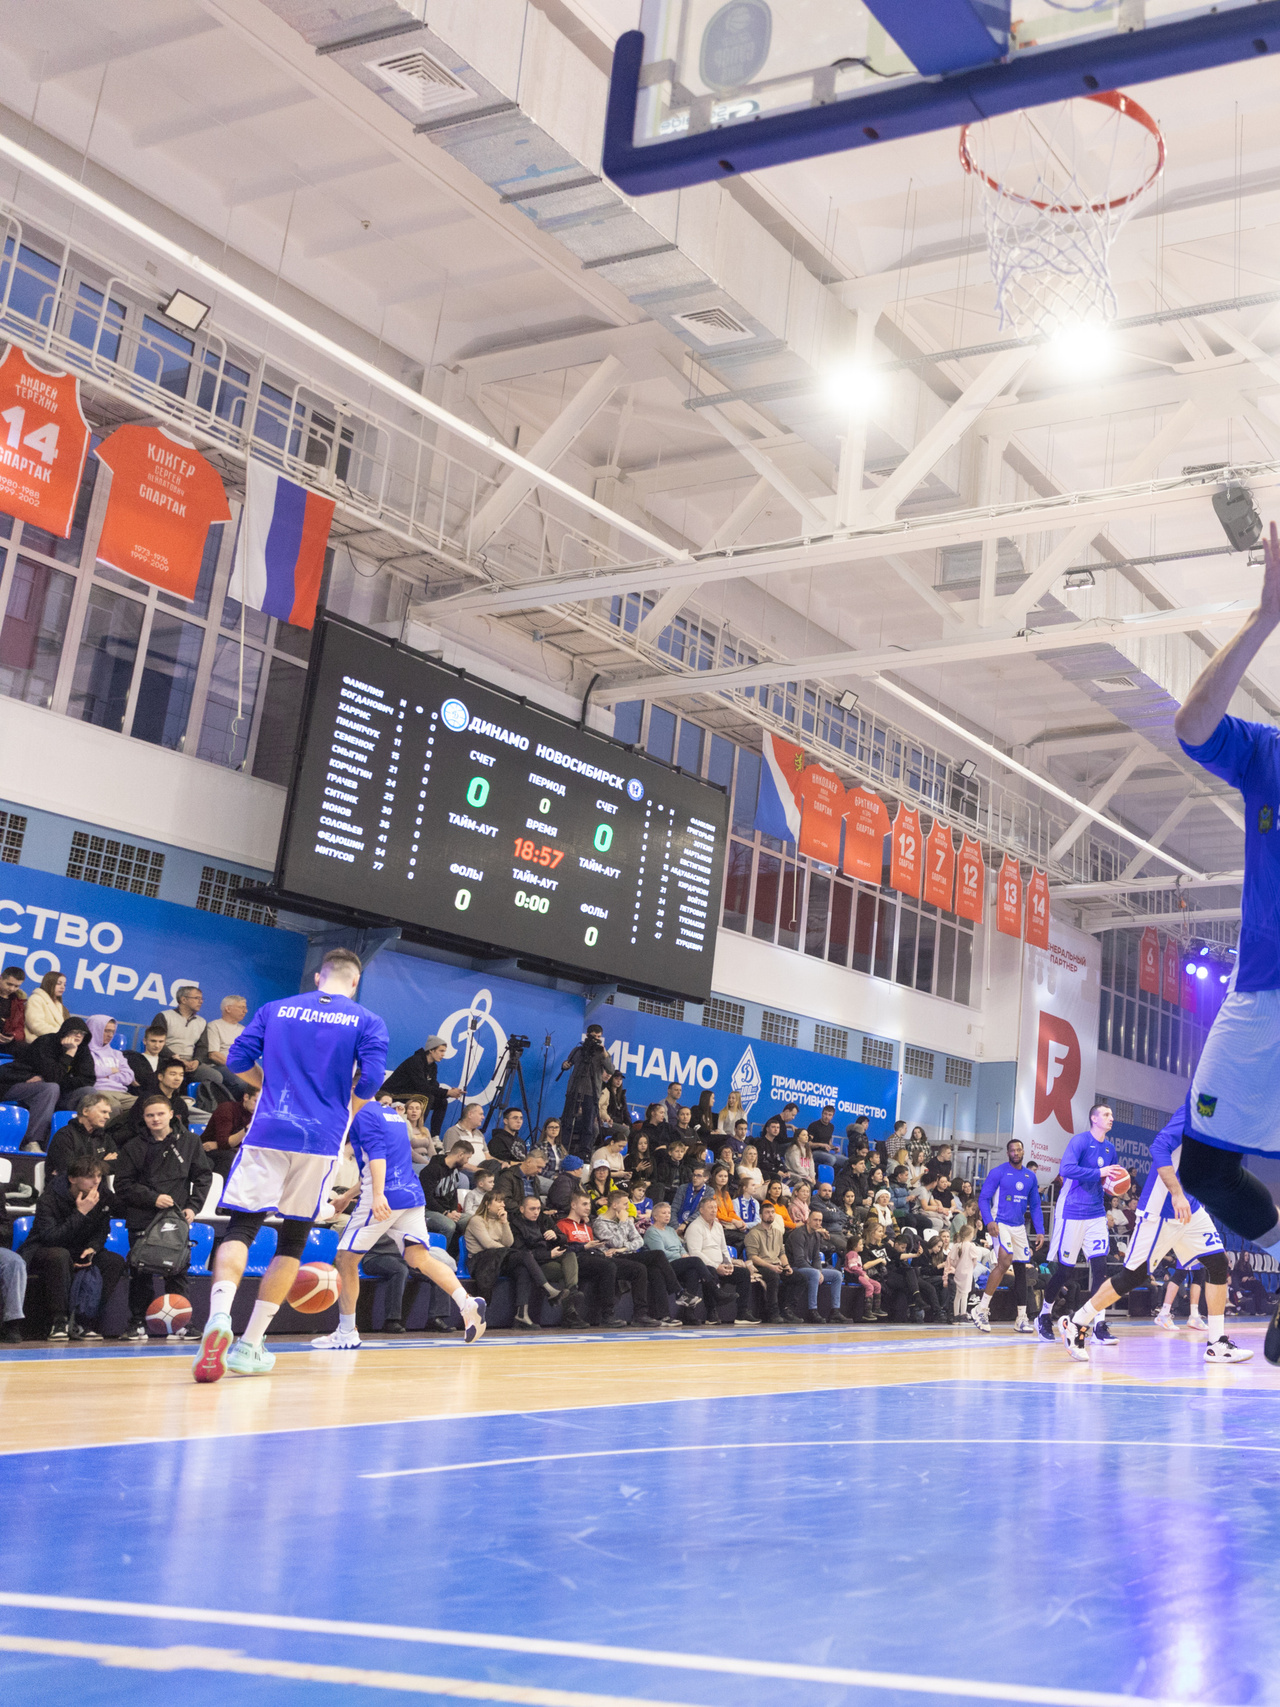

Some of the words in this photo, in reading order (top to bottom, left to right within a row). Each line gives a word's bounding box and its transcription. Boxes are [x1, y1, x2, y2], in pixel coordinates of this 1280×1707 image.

[15, 384, 58, 414] ТЕРЕХИН
[20, 374, 58, 400] АНДРЕЙ
[1, 405, 60, 466] 14
[147, 443, 196, 478] КЛИГЕР
[154, 465, 182, 486] СЕРГЕЙ
[139, 483, 187, 518] СПАРТАК
[130, 550, 169, 572] 1999-2009
[343, 676, 384, 698] ФАМИЛИЯ
[340, 688, 394, 715] БОГДАНОВИЧ
[398, 711, 404, 719] 3
[338, 702, 371, 720] ХАРРИС
[428, 737, 434, 745] 0
[334, 730, 375, 751] СЕМЕНЮК
[391, 751, 400, 760] 15
[336, 716, 381, 738] ПИЛИПЧУК
[394, 738, 401, 746] 11
[426, 750, 432, 758] 0
[331, 744, 367, 763] СМЫГИН
[388, 765, 398, 774] 21
[468, 717, 529, 750] ДИНАМО
[535, 743, 626, 790] НОВОСИБИРСК
[469, 750, 496, 767] СЧЕТ
[329, 758, 373, 779] КОРЧАГИН
[385, 778, 396, 788] 24
[420, 790, 426, 798] 0
[528, 772, 566, 797] ПЕРИОД
[326, 772, 358, 789] ГРАЧЕВ
[383, 792, 394, 801] 25
[418, 804, 424, 812] 0
[467, 776, 490, 808] 0
[322, 801, 352, 817] ИОНОВ
[379, 820, 390, 829] 36
[324, 787, 359, 804] СИТНИК
[381, 806, 392, 815] 30
[416, 817, 422, 825] 0
[539, 798, 551, 814] 0
[596, 799, 618, 815] СЧЕТ
[320, 816, 363, 835] СОЛОВЬЕВ
[378, 834, 388, 843] 41
[412, 844, 418, 852] 0
[448, 812, 499, 838] ТАЙМ-АУТ
[526, 818, 558, 837] ВРЕМЯ
[594, 823, 613, 852] 0
[315, 844, 354, 862] МИТУСОВ
[372, 861, 384, 870] 77
[317, 830, 365, 851] ФЕДЮШИН
[375, 847, 386, 857] 54
[410, 858, 416, 866] 0
[514, 838, 564, 869] 18:57
[898, 833, 916, 860] 12
[450, 863, 483, 881] ФОЛЫ
[579, 857, 621, 879] ТАЙМ-АУТ
[936, 849, 946, 872] 7
[512, 868, 558, 891] ТАЙМ-АУТ
[963, 863, 978, 889] 12
[454, 889, 471, 910] 0
[514, 891, 550, 914] 0:00
[1004, 881, 1017, 904] 13
[580, 903, 608, 919] ФОЛЫ
[1032, 894, 1045, 918] 14
[584, 926, 598, 946] 0
[1050, 954, 1078, 972] ПАРТНЕР
[1147, 948, 1154, 966] 6
[277, 1006, 360, 1027] БОГДАНОВИЧ
[582, 1034, 718, 1090] ИНАМО
[772, 1074, 838, 1098] ПРИМОРСКОЕ
[770, 1088, 836, 1108] СПОРТИВНОЕ
[838, 1100, 886, 1120] ОБЩЕСТВО
[1031, 1140, 1048, 1152] Русская
[1092, 1239, 1106, 1250] 21
